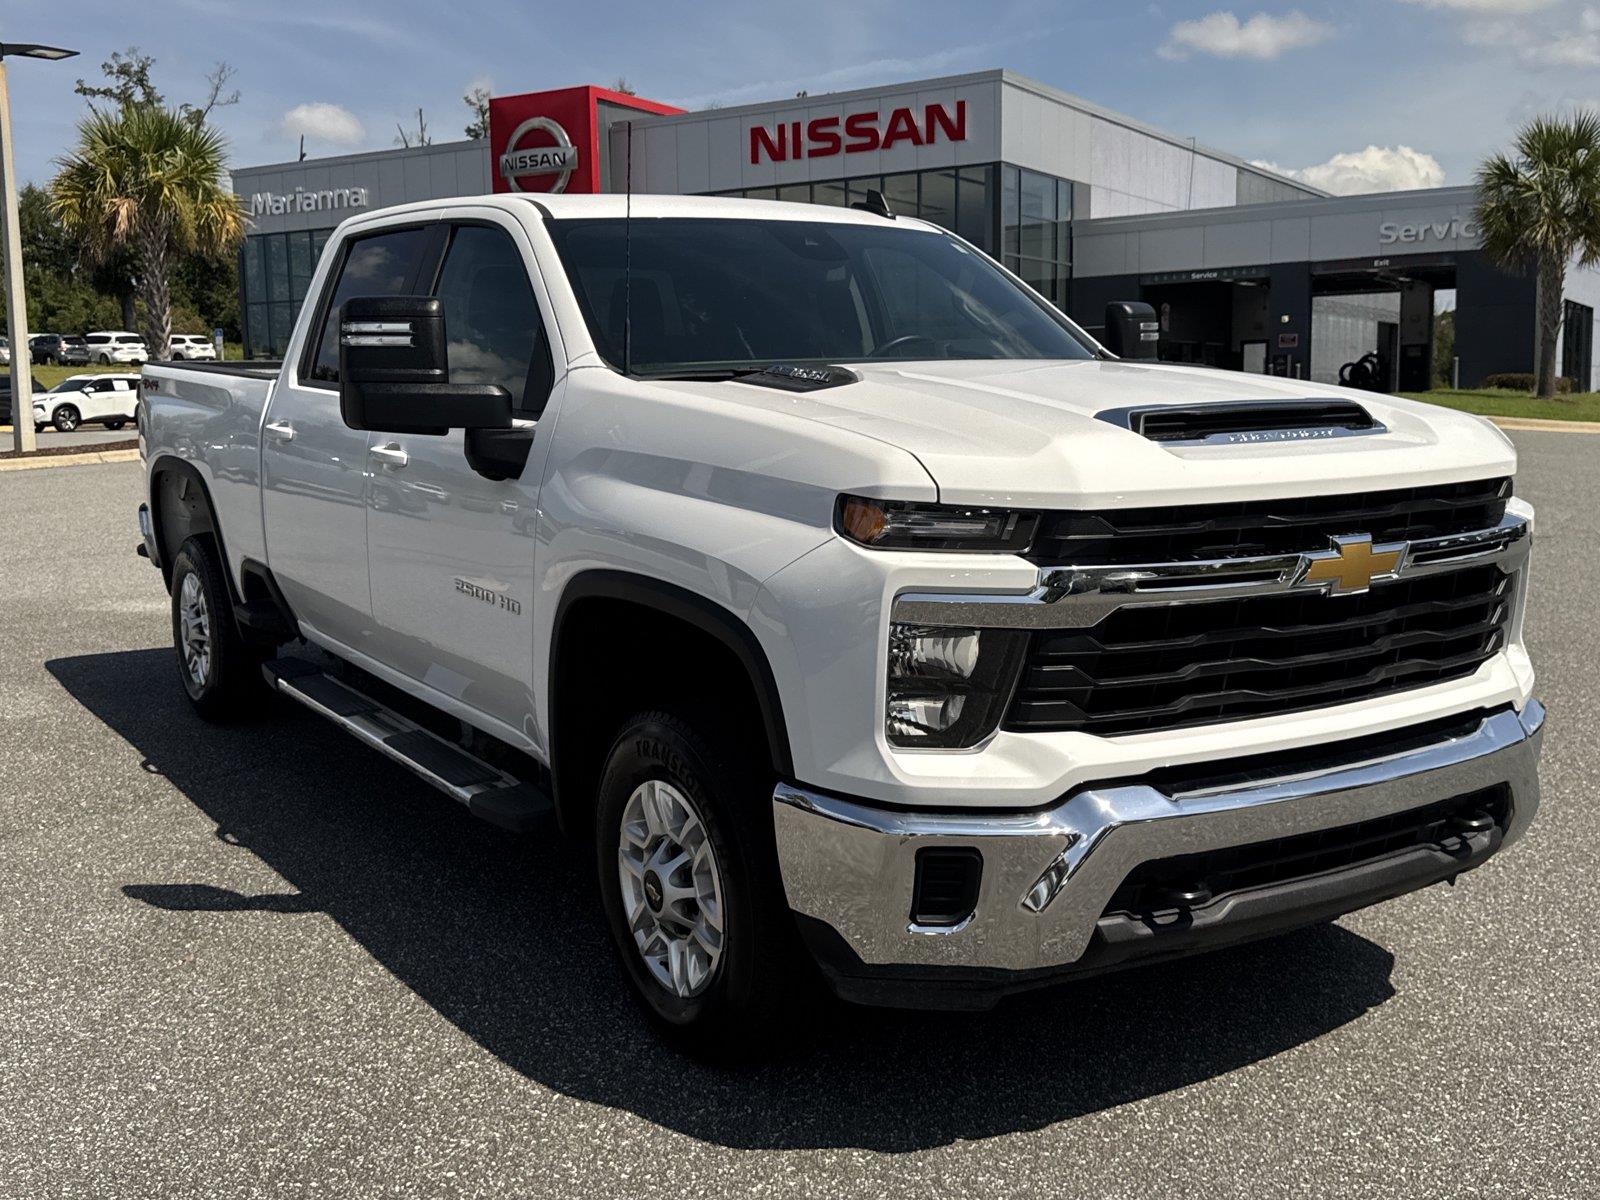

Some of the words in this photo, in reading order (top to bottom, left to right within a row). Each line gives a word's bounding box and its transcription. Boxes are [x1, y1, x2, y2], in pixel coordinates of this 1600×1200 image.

[749, 100, 966, 164] NISSAN
[504, 152, 566, 171] NISSAN
[251, 187, 368, 216] Marianna
[1379, 216, 1484, 244] Servic
[1191, 272, 1218, 280] Service
[499, 595, 520, 615] HD
